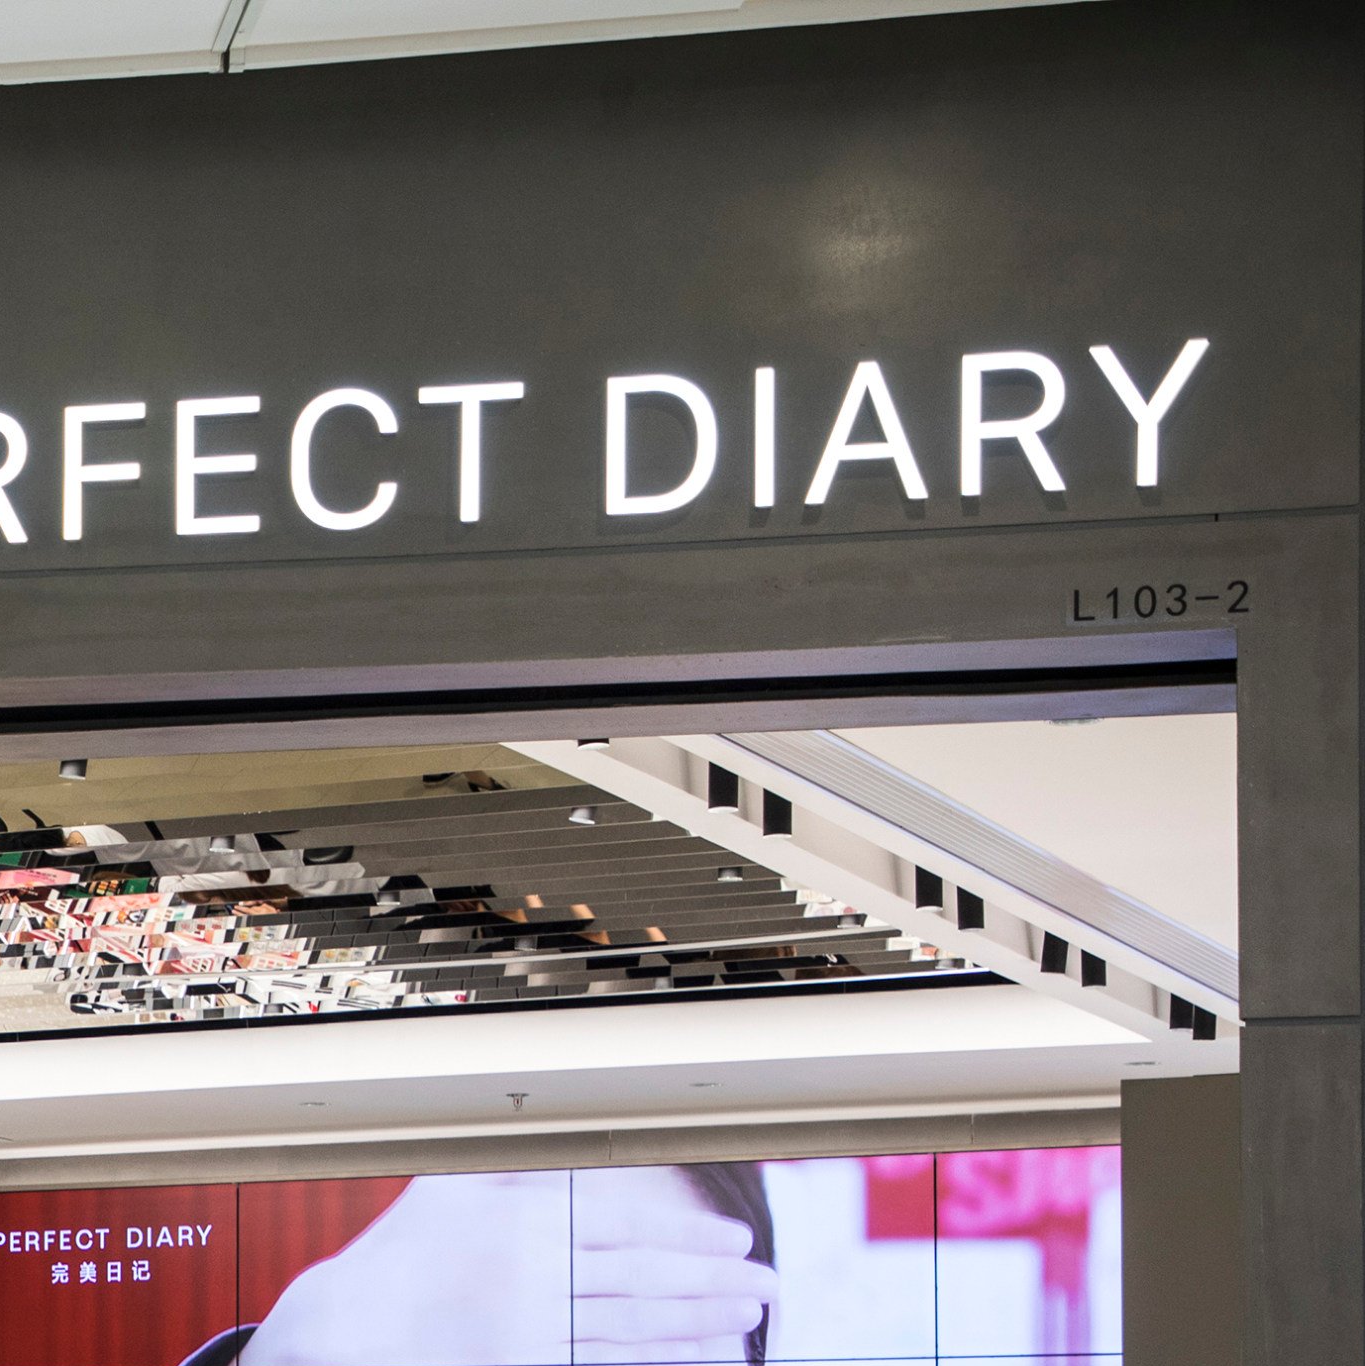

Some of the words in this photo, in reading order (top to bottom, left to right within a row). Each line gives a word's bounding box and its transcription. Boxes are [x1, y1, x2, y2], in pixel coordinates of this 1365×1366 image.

[604, 338, 1209, 516] DIARY
[1073, 580, 1250, 621] L103-2
[126, 1224, 213, 1249] DIARY
[51, 1260, 150, 1284] 完美日记
